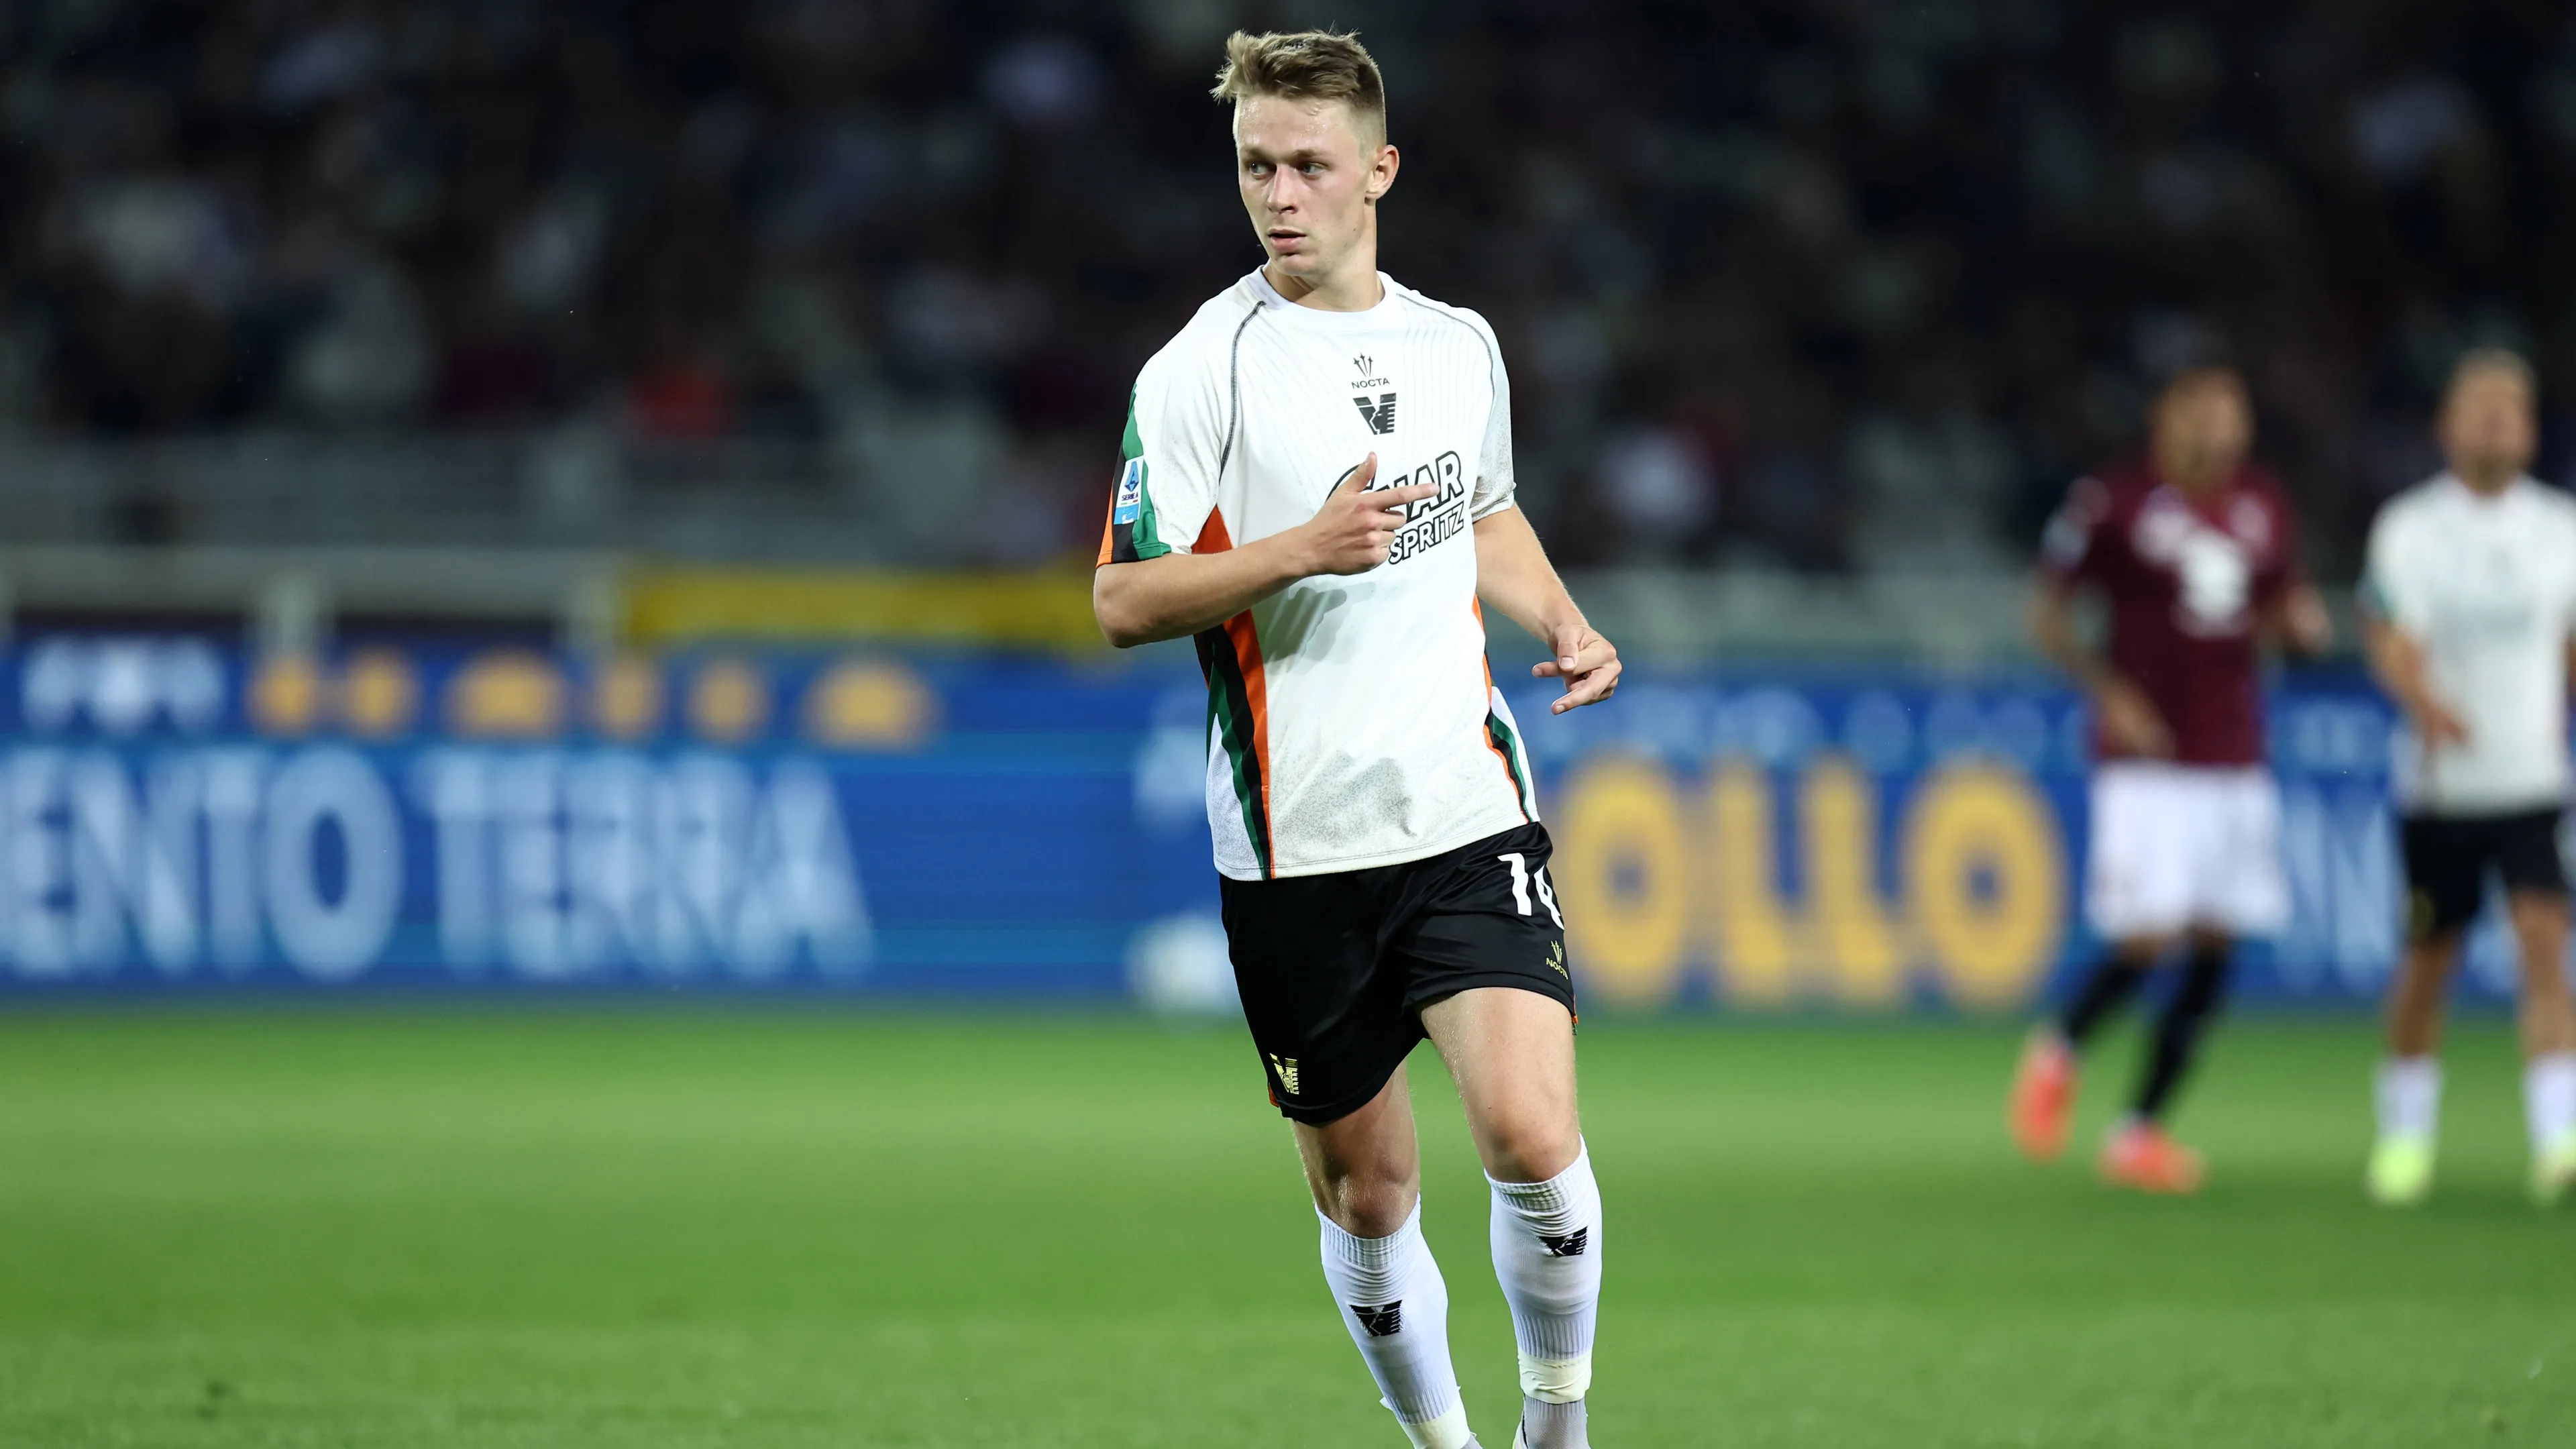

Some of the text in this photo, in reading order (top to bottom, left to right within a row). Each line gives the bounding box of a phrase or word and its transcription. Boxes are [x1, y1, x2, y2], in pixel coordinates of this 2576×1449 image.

[1351, 378, 1391, 389] NOCTA
[1121, 492, 1135, 502] SERIE
[1388, 500, 1465, 565] SPRITZ
[406, 743, 879, 983] TERRA
